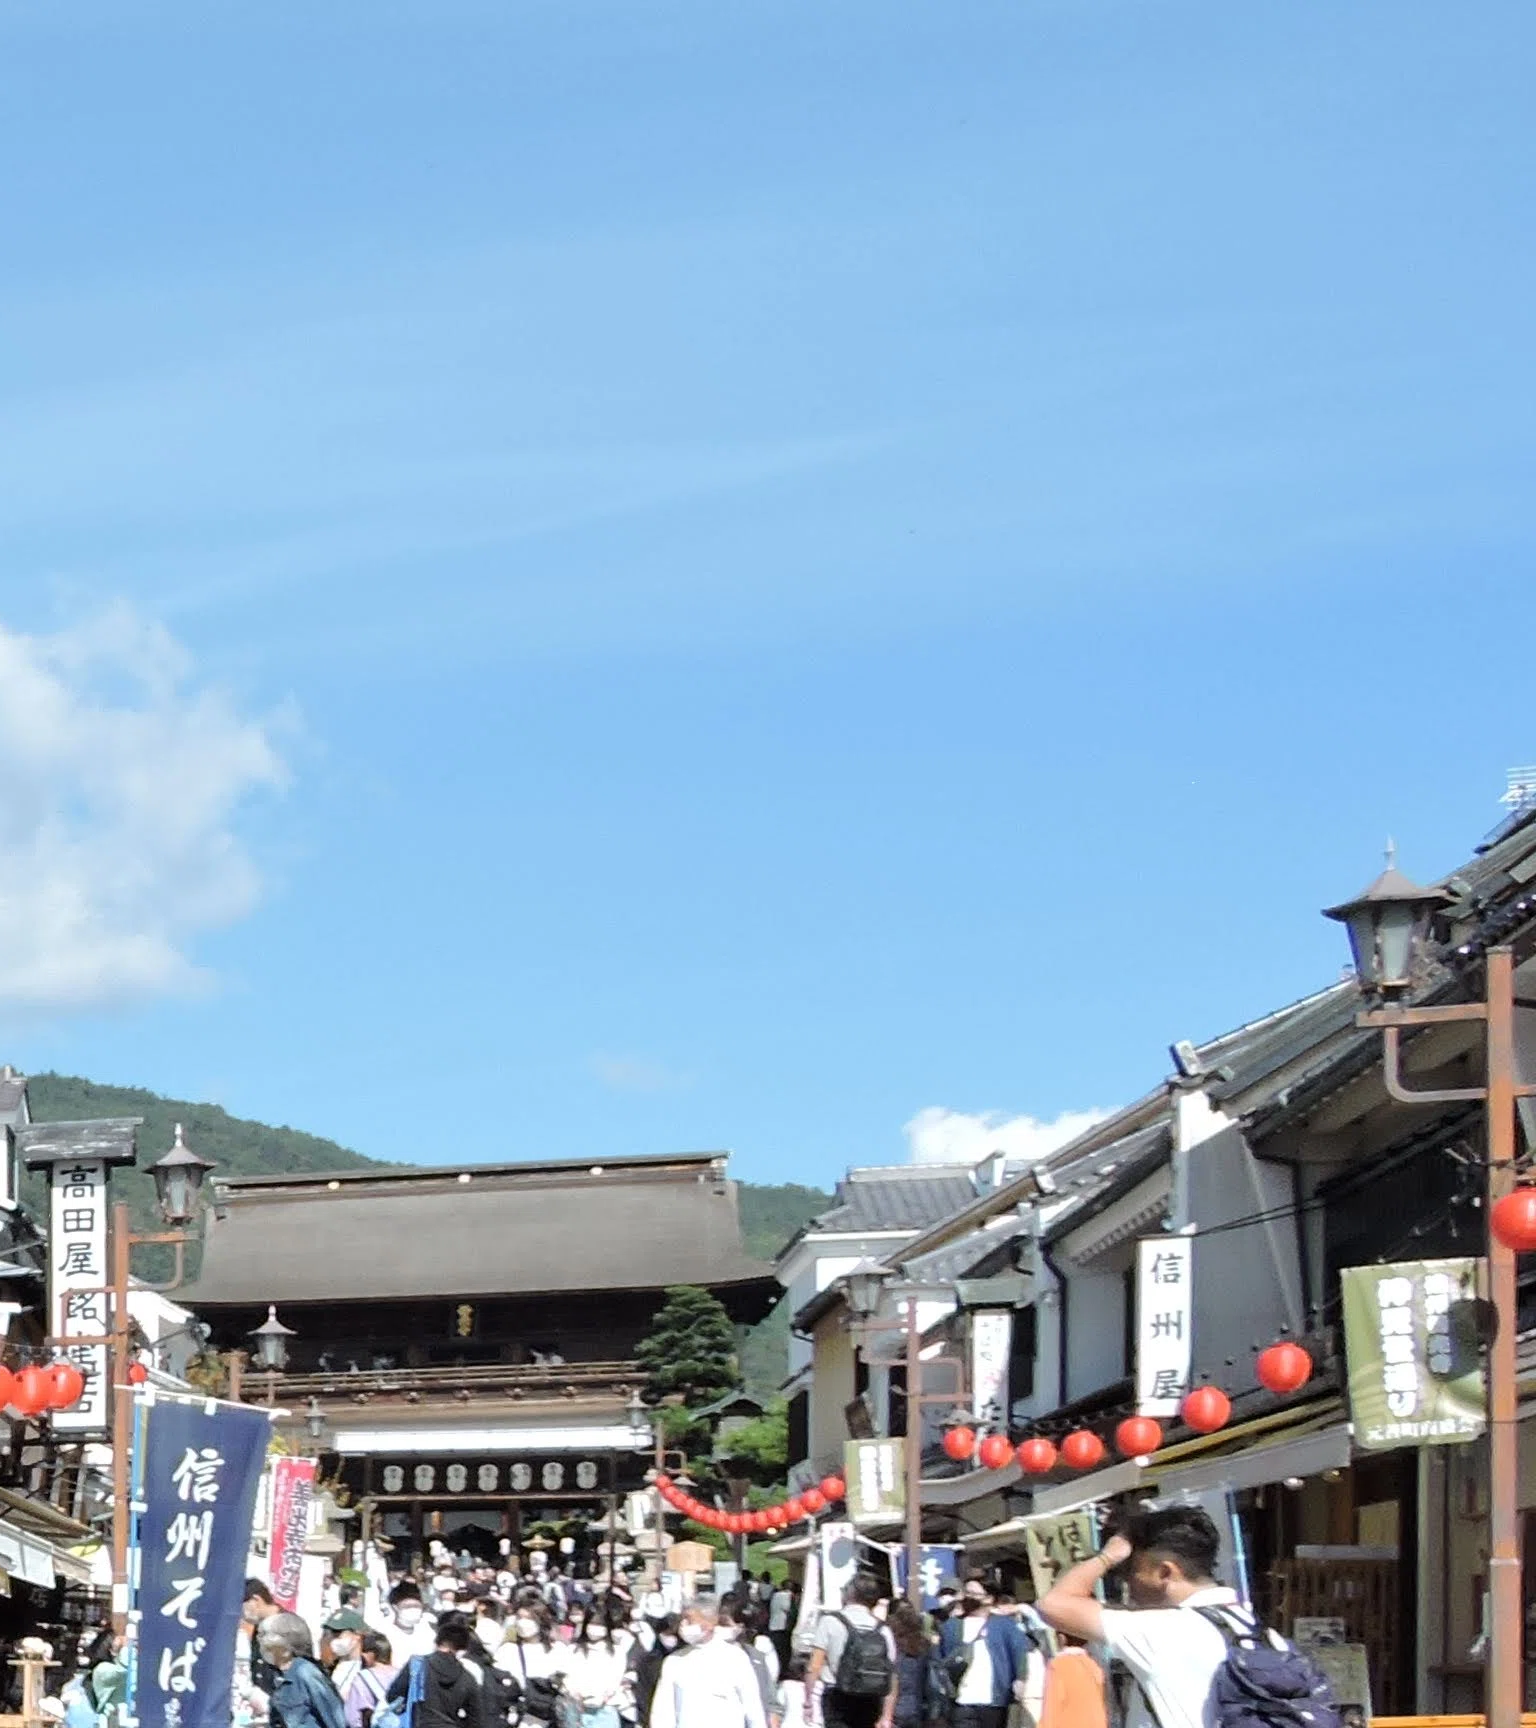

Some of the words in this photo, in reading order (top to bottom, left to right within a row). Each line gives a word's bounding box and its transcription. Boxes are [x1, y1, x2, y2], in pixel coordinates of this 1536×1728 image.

[1149, 1250, 1186, 1400] 信州屋
[157, 1446, 227, 1698] 信州そば
